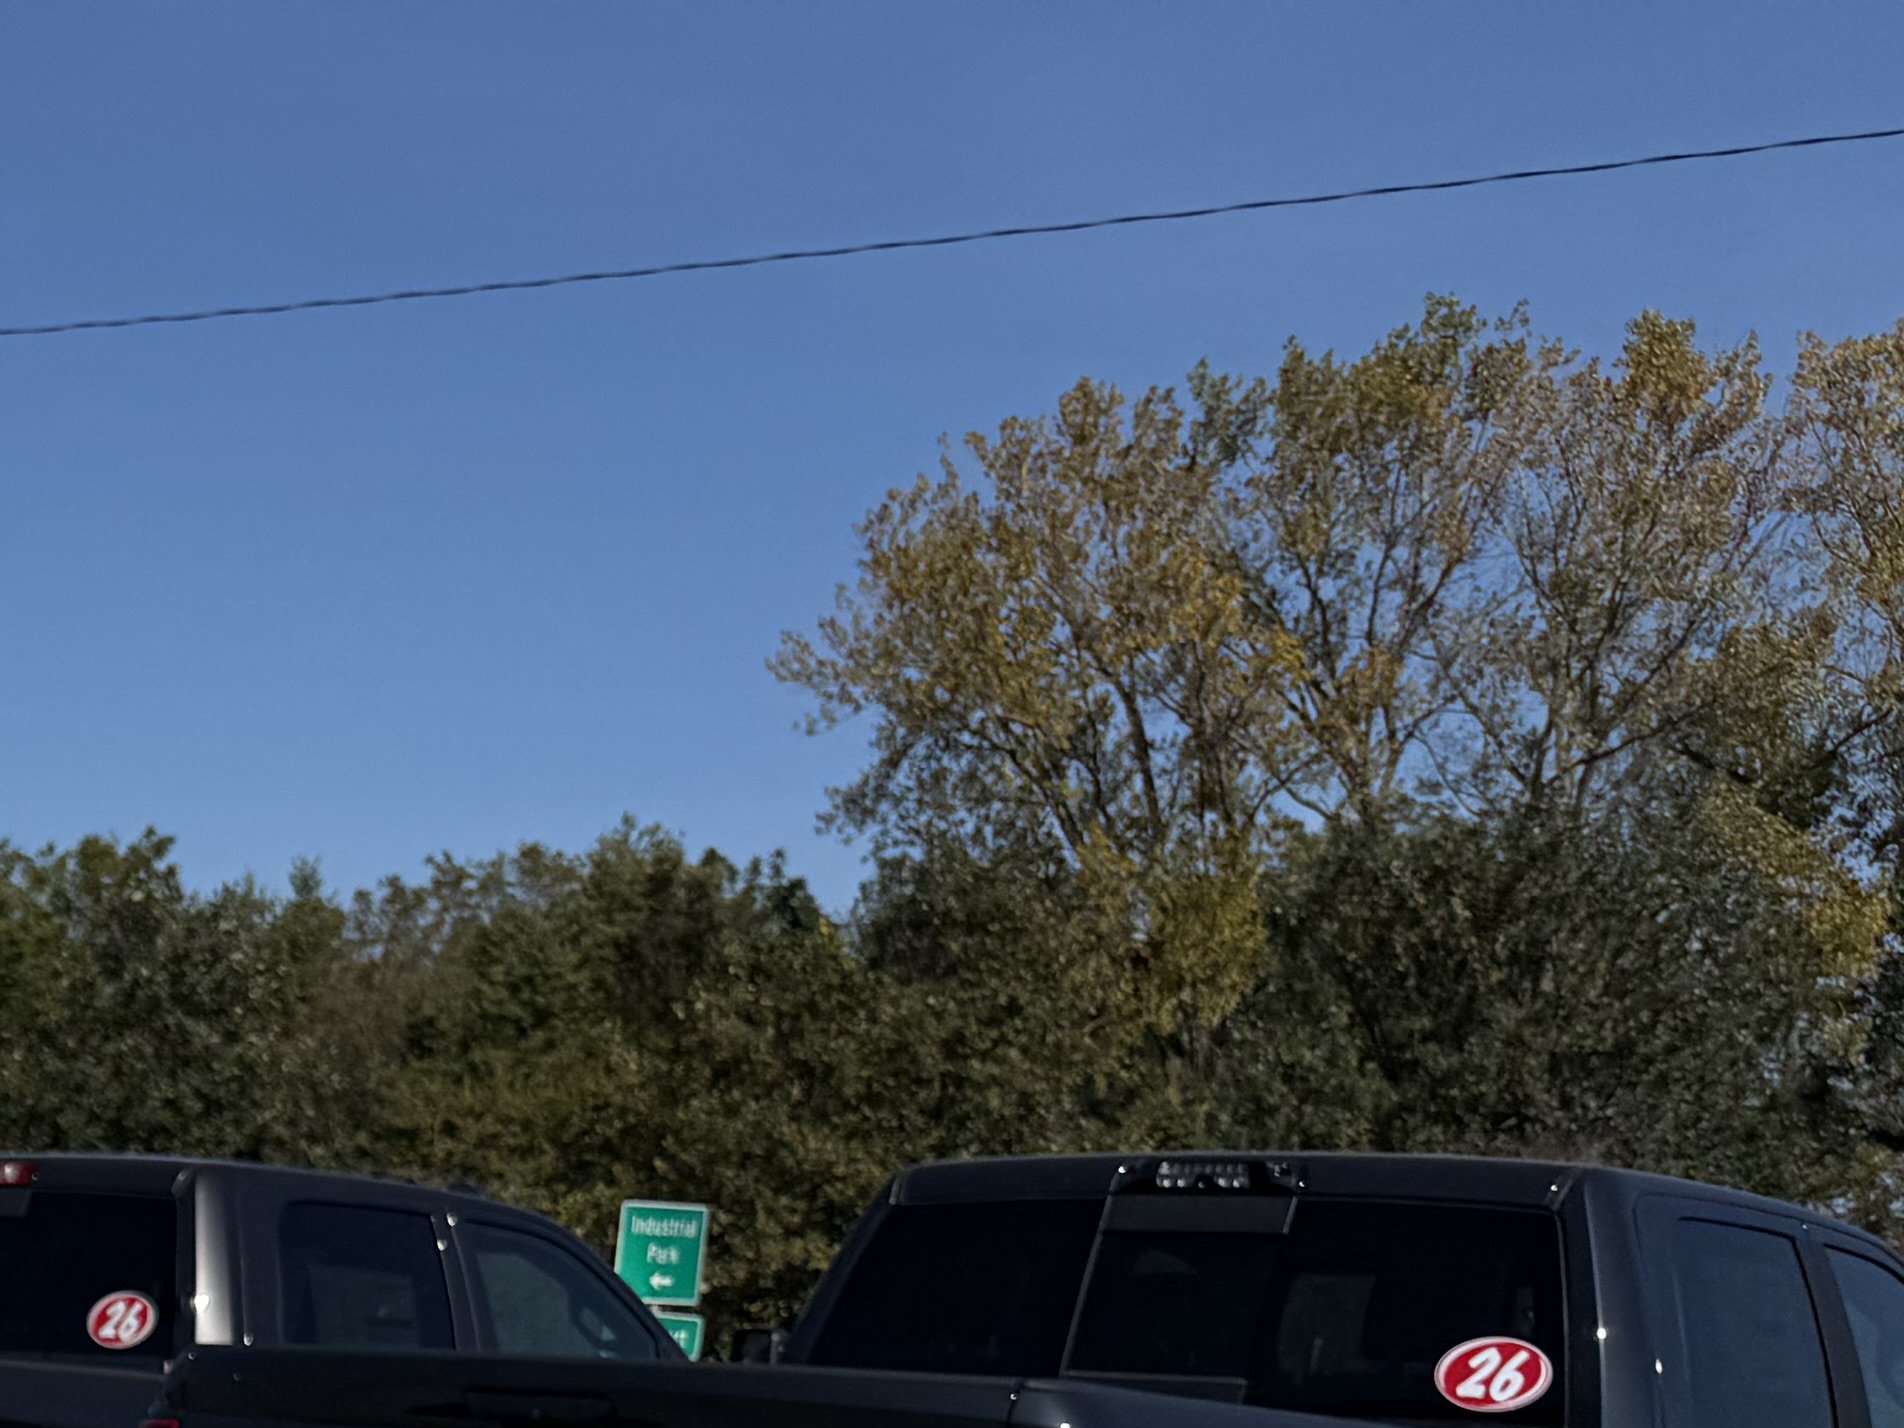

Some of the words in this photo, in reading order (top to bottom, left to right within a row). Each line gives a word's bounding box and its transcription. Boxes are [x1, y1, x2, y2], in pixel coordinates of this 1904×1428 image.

[631, 1216, 698, 1237] Industrial
[646, 1243, 680, 1264] Park
[98, 1300, 144, 1342] 26
[1455, 1346, 1530, 1402] 26
